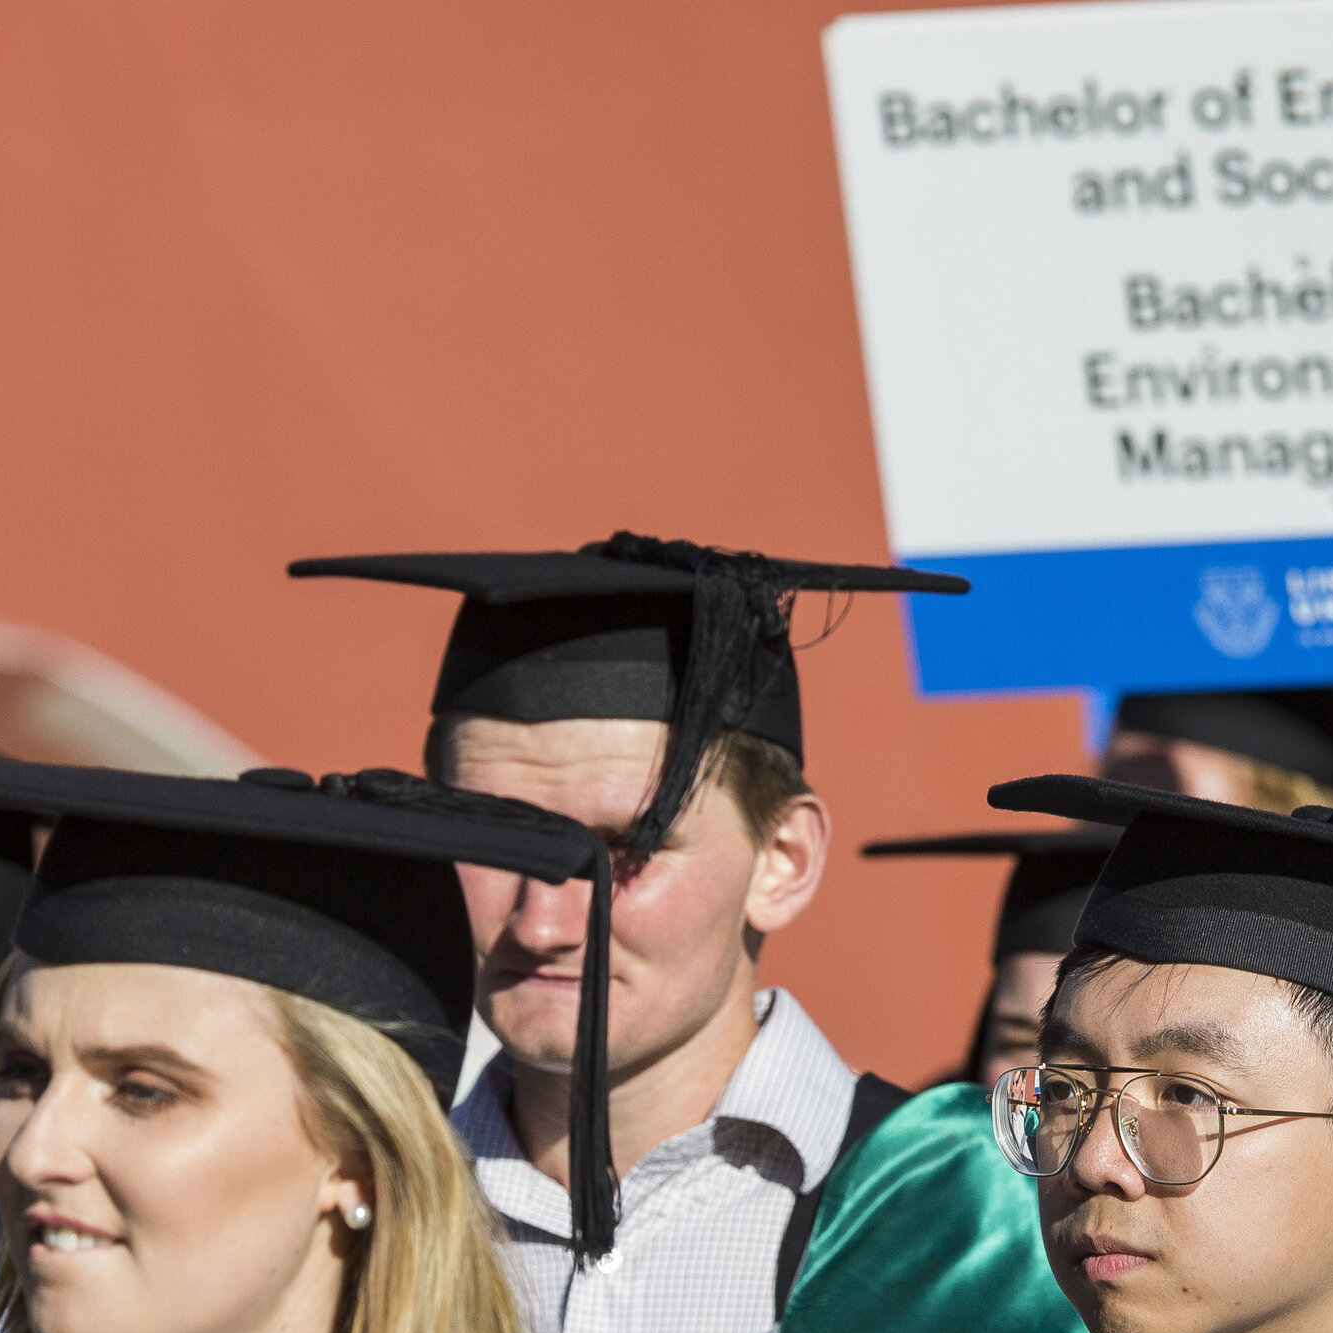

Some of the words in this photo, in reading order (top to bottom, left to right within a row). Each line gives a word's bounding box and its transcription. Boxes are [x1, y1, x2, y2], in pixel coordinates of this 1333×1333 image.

[880, 77, 1167, 148] Bachelor
[1192, 71, 1255, 132] of
[1073, 149, 1193, 212] and
